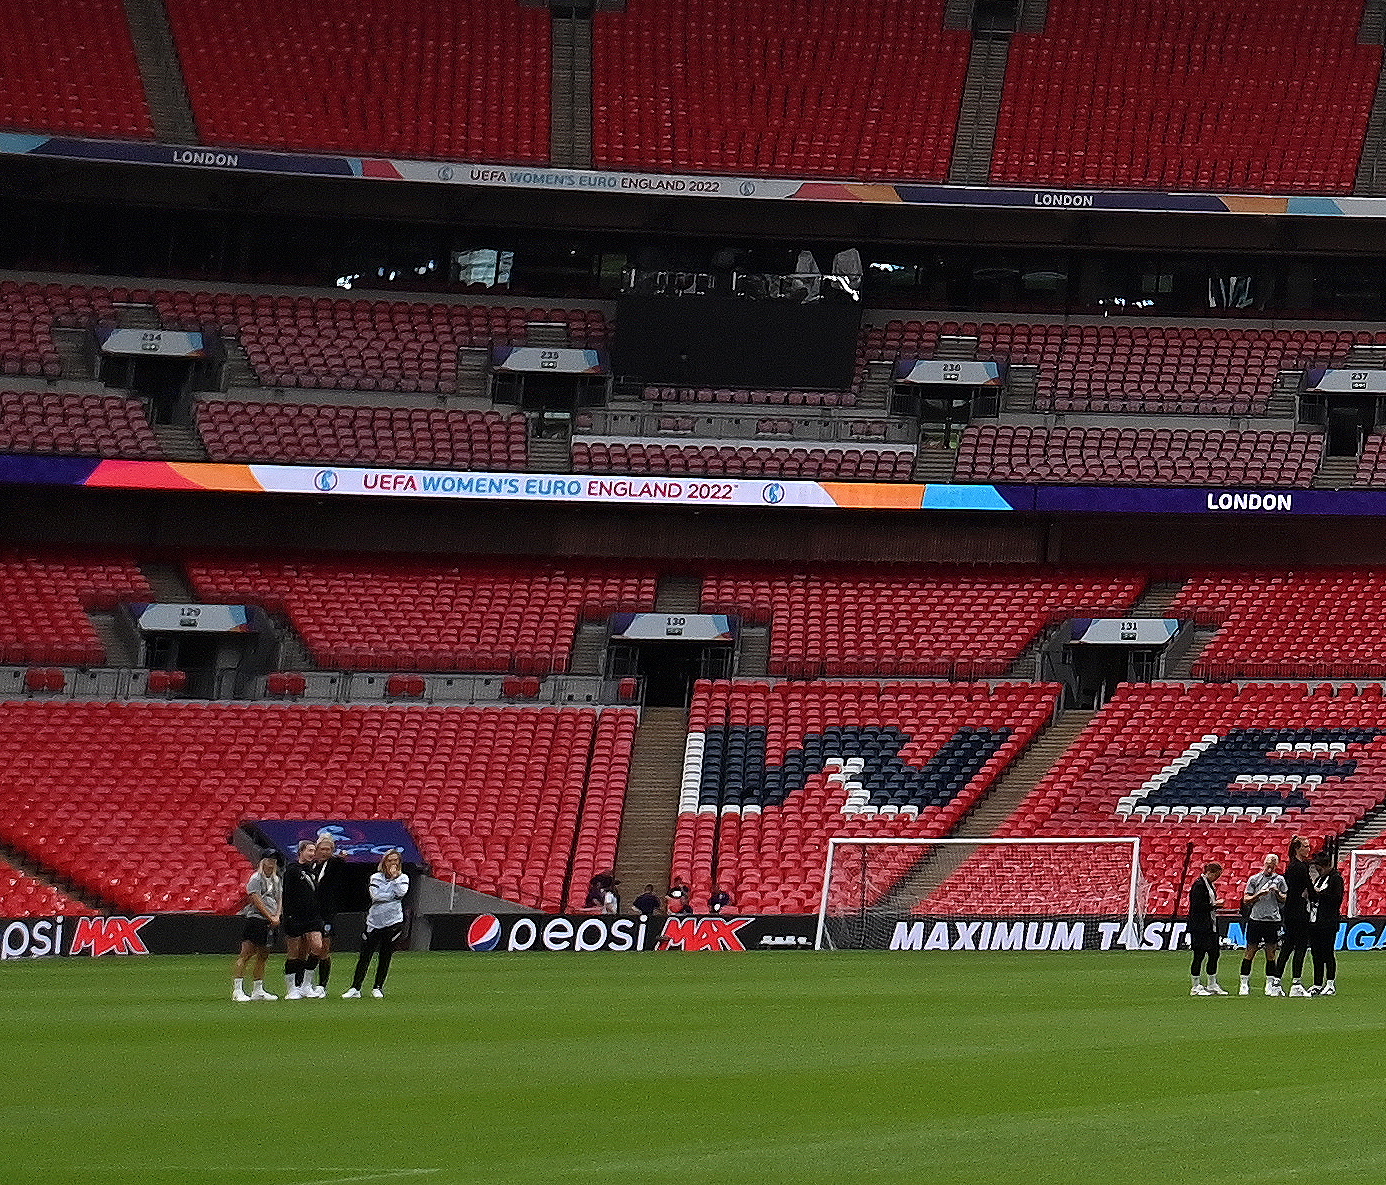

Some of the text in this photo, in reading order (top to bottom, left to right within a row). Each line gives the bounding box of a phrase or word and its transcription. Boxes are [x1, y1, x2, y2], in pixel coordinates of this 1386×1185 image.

[173, 150, 239, 167] LONDON
[470, 169, 720, 193] UEFA WOMEN'S EURO ENGLAND 2022
[1034, 193, 1094, 207] LONDON
[363, 473, 734, 500] UEFA WOMEN'S EURO ENGLAND 2022
[1207, 493, 1292, 510] LONDON
[666, 617, 686, 627] 130
[1120, 622, 1138, 631] 131
[69, 916, 155, 957] MAX
[508, 915, 755, 952] pepsi MAX
[889, 922, 1084, 951] MAXIMUM
[1098, 922, 1192, 950] TAST
